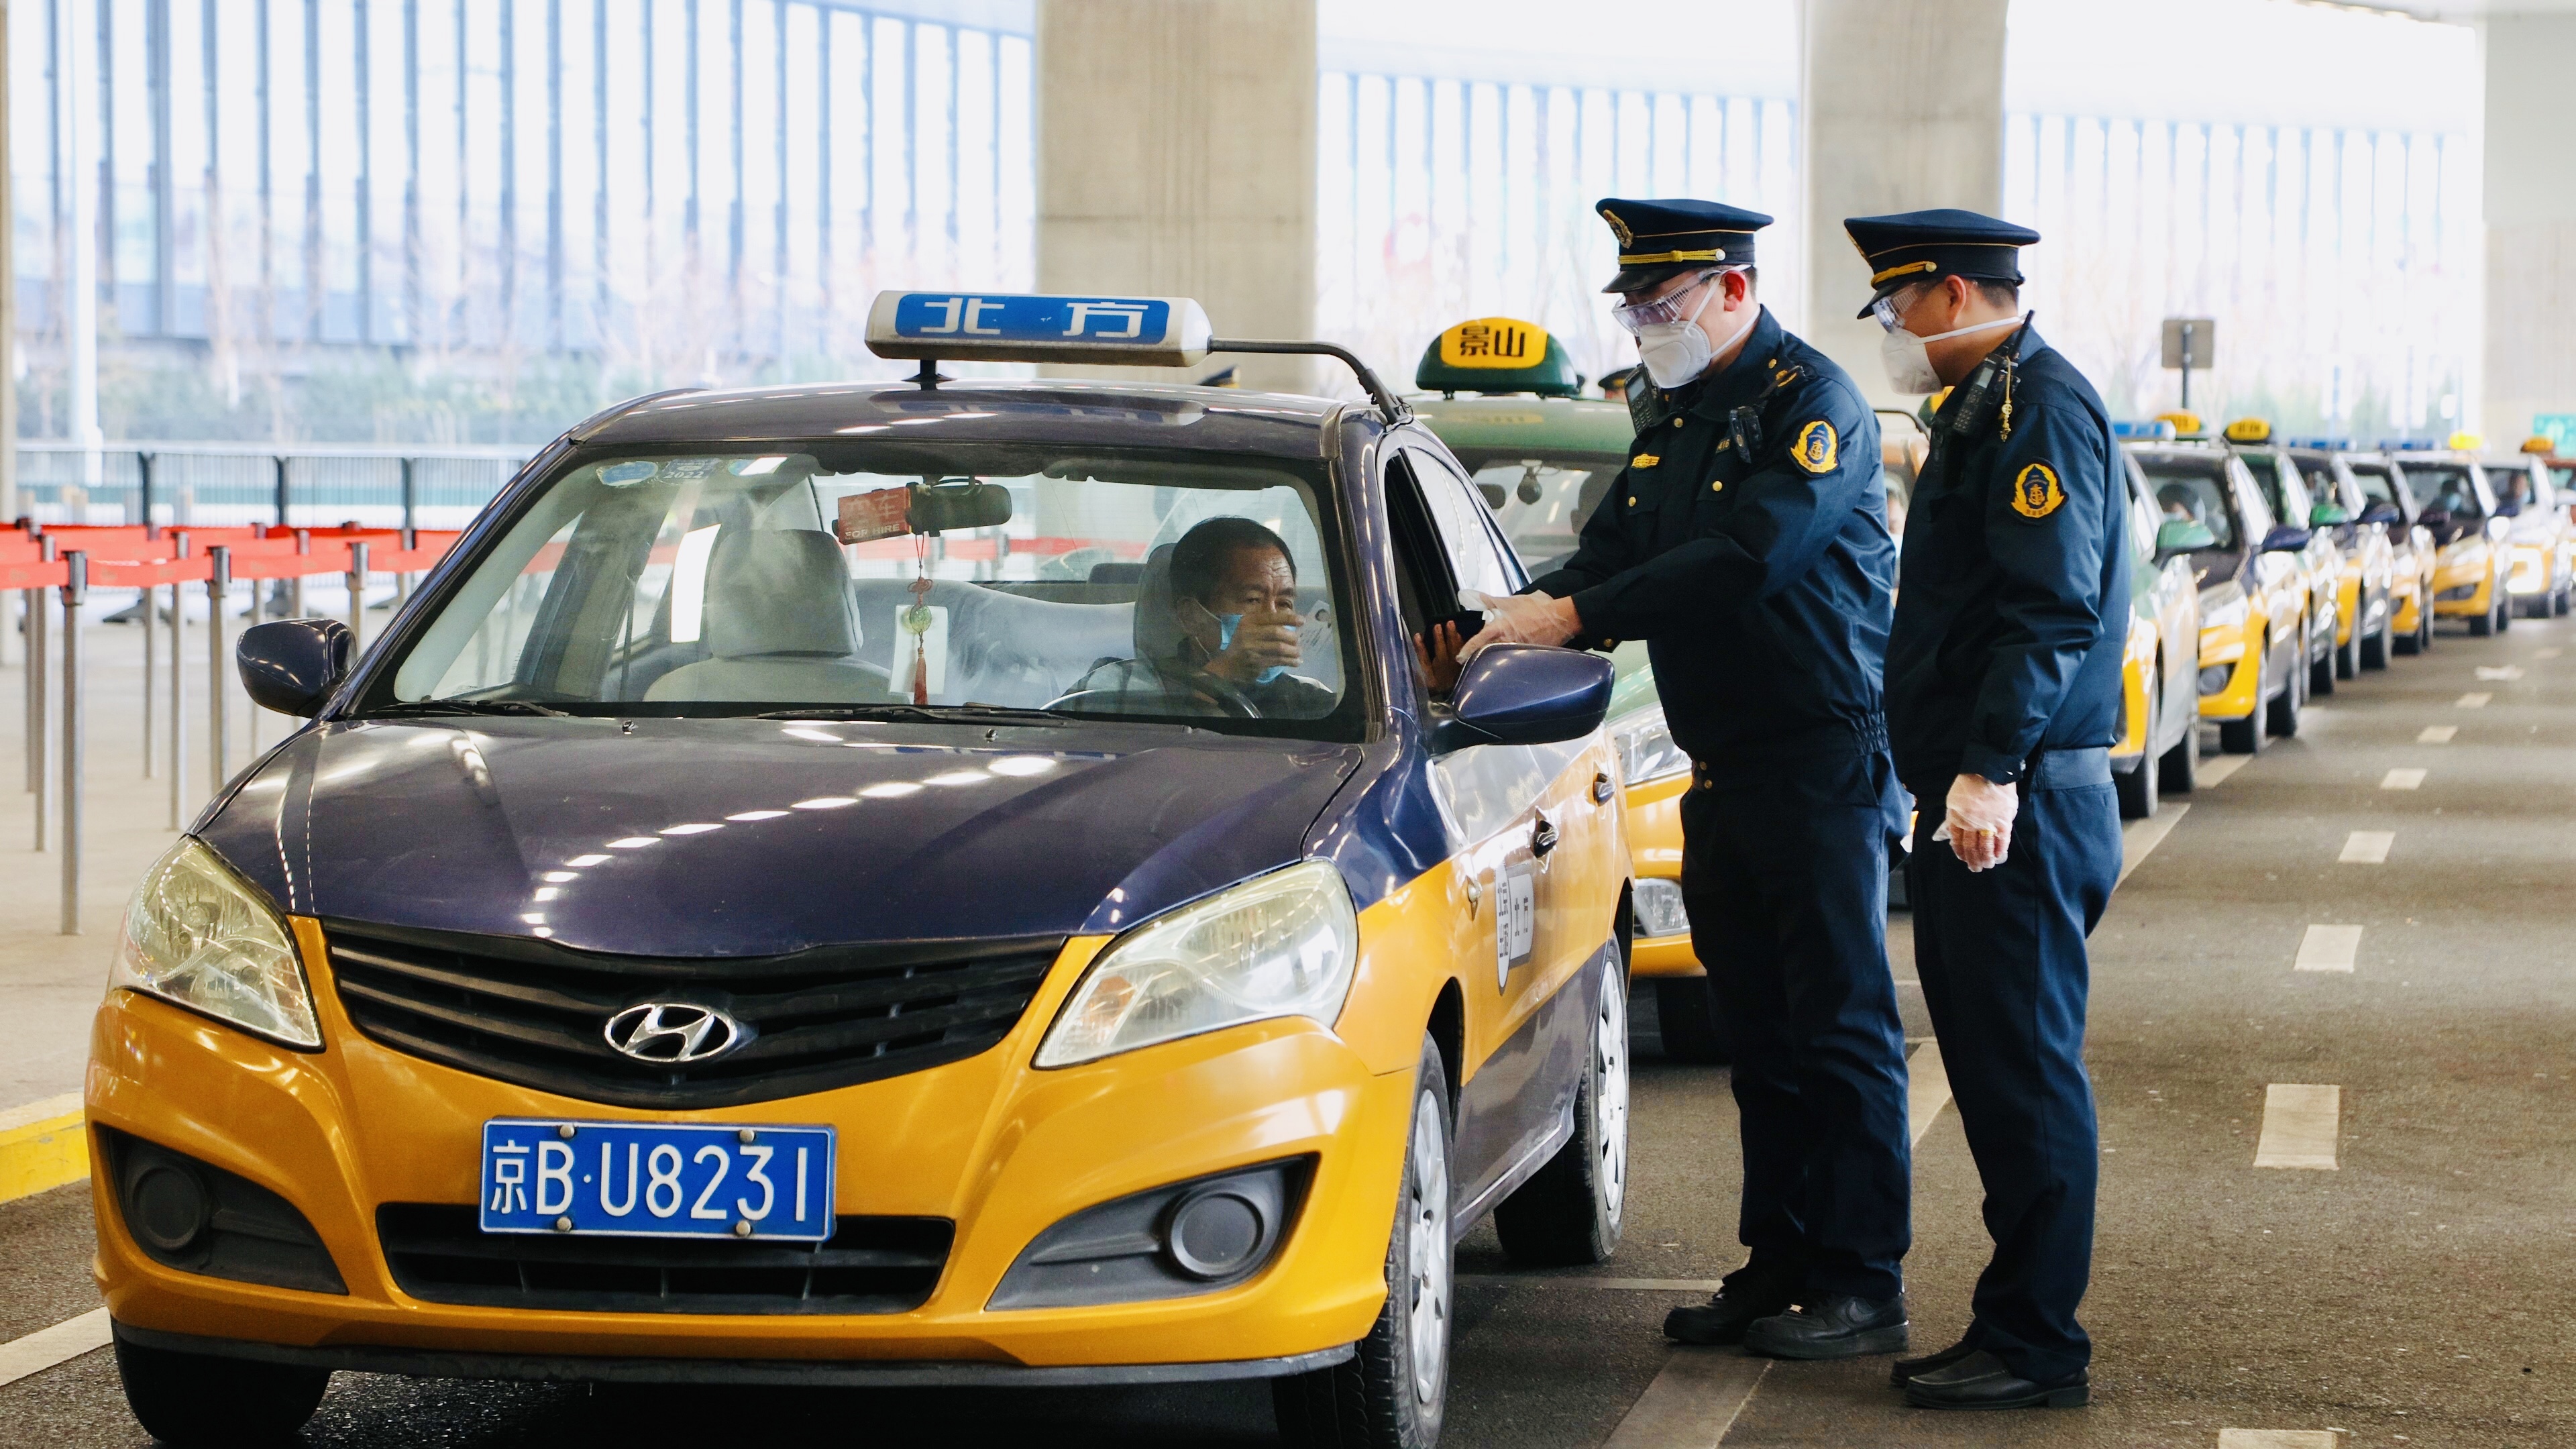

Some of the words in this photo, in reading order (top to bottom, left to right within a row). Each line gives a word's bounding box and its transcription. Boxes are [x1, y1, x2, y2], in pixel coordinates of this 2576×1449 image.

[920, 297, 1149, 338] 北方
[1460, 325, 1526, 358] 景山
[663, 471, 705, 479] 2022
[873, 523, 900, 535] HIRE
